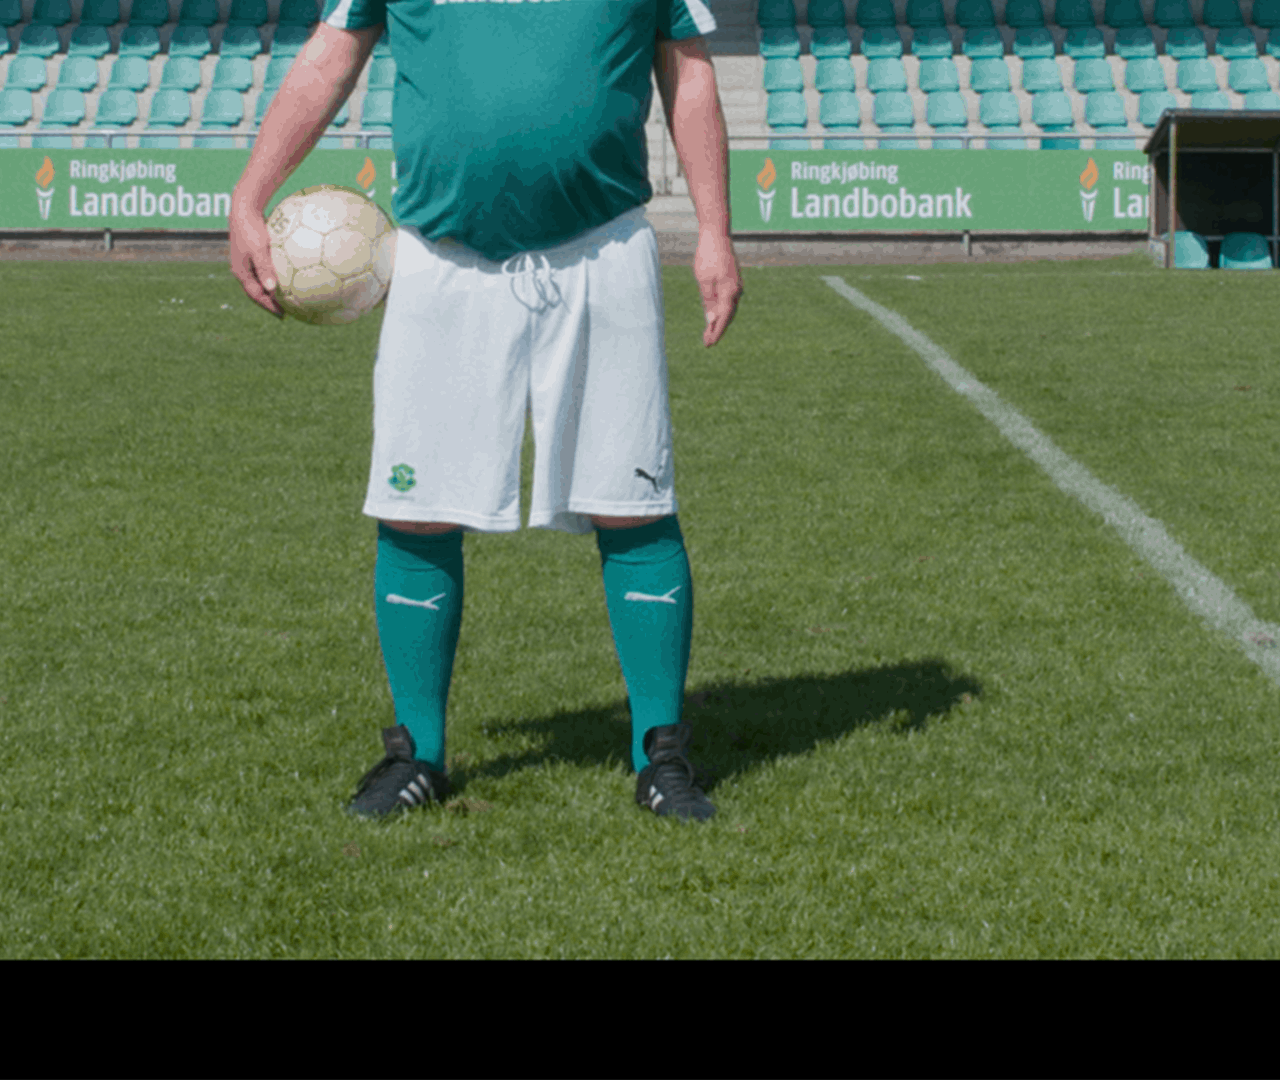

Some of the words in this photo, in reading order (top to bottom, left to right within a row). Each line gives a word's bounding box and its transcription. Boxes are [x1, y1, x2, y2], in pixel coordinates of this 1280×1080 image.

[69, 159, 176, 183] Ringkjøbing
[791, 161, 898, 184] Ringkjøbing
[69, 185, 232, 217] Landboban
[791, 187, 972, 219] Landbobank
